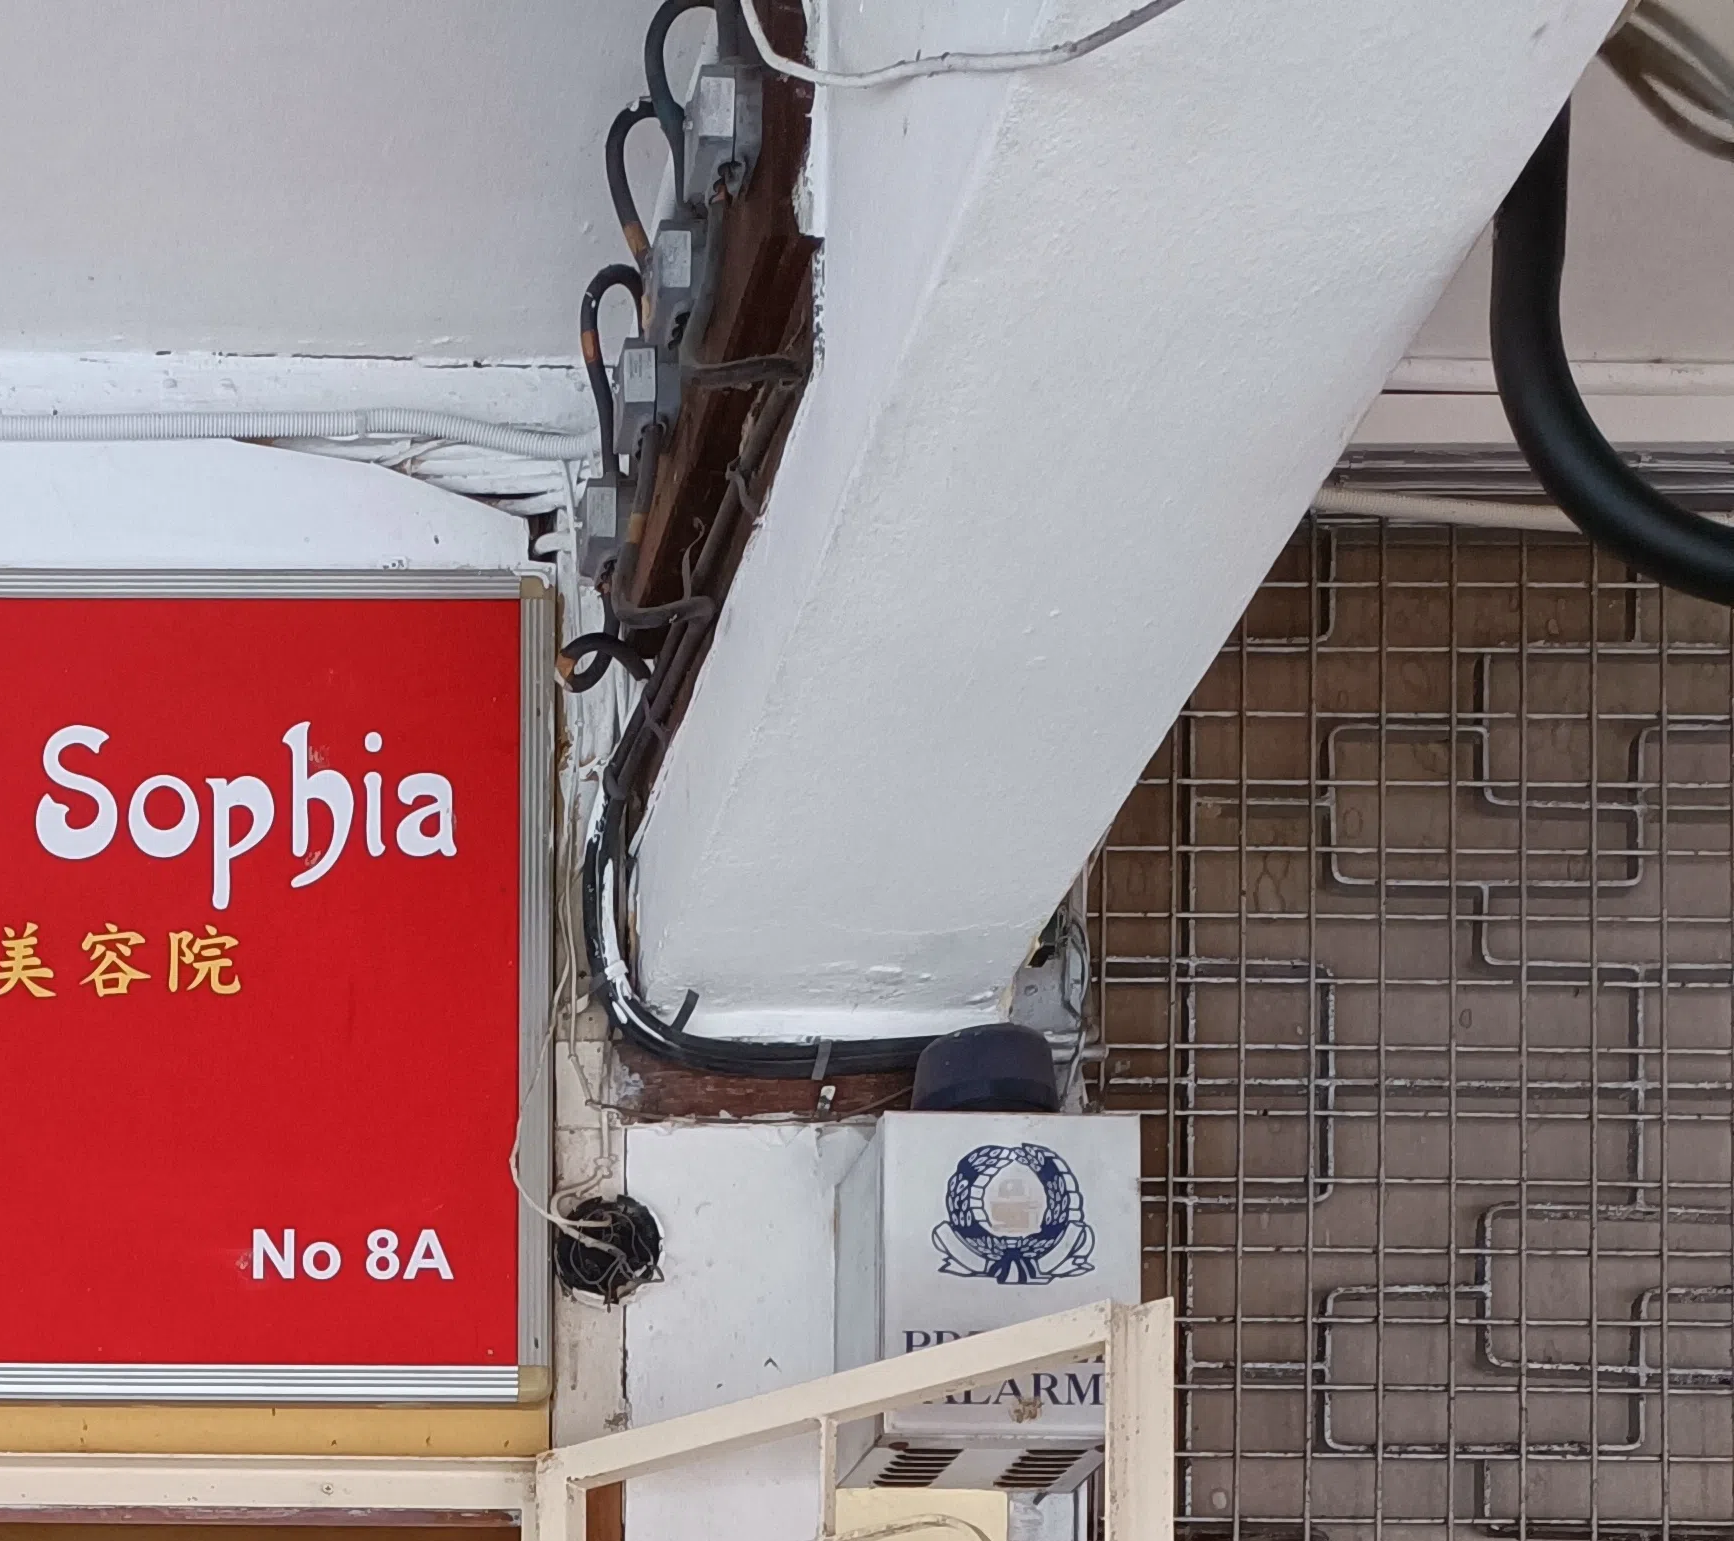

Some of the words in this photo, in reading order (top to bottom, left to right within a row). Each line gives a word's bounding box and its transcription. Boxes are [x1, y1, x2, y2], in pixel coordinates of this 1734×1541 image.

[35, 721, 457, 910] Sophia
[252, 1228, 342, 1280] No
[365, 1228, 454, 1280] 8A
[923, 1372, 1105, 1406] LARM
